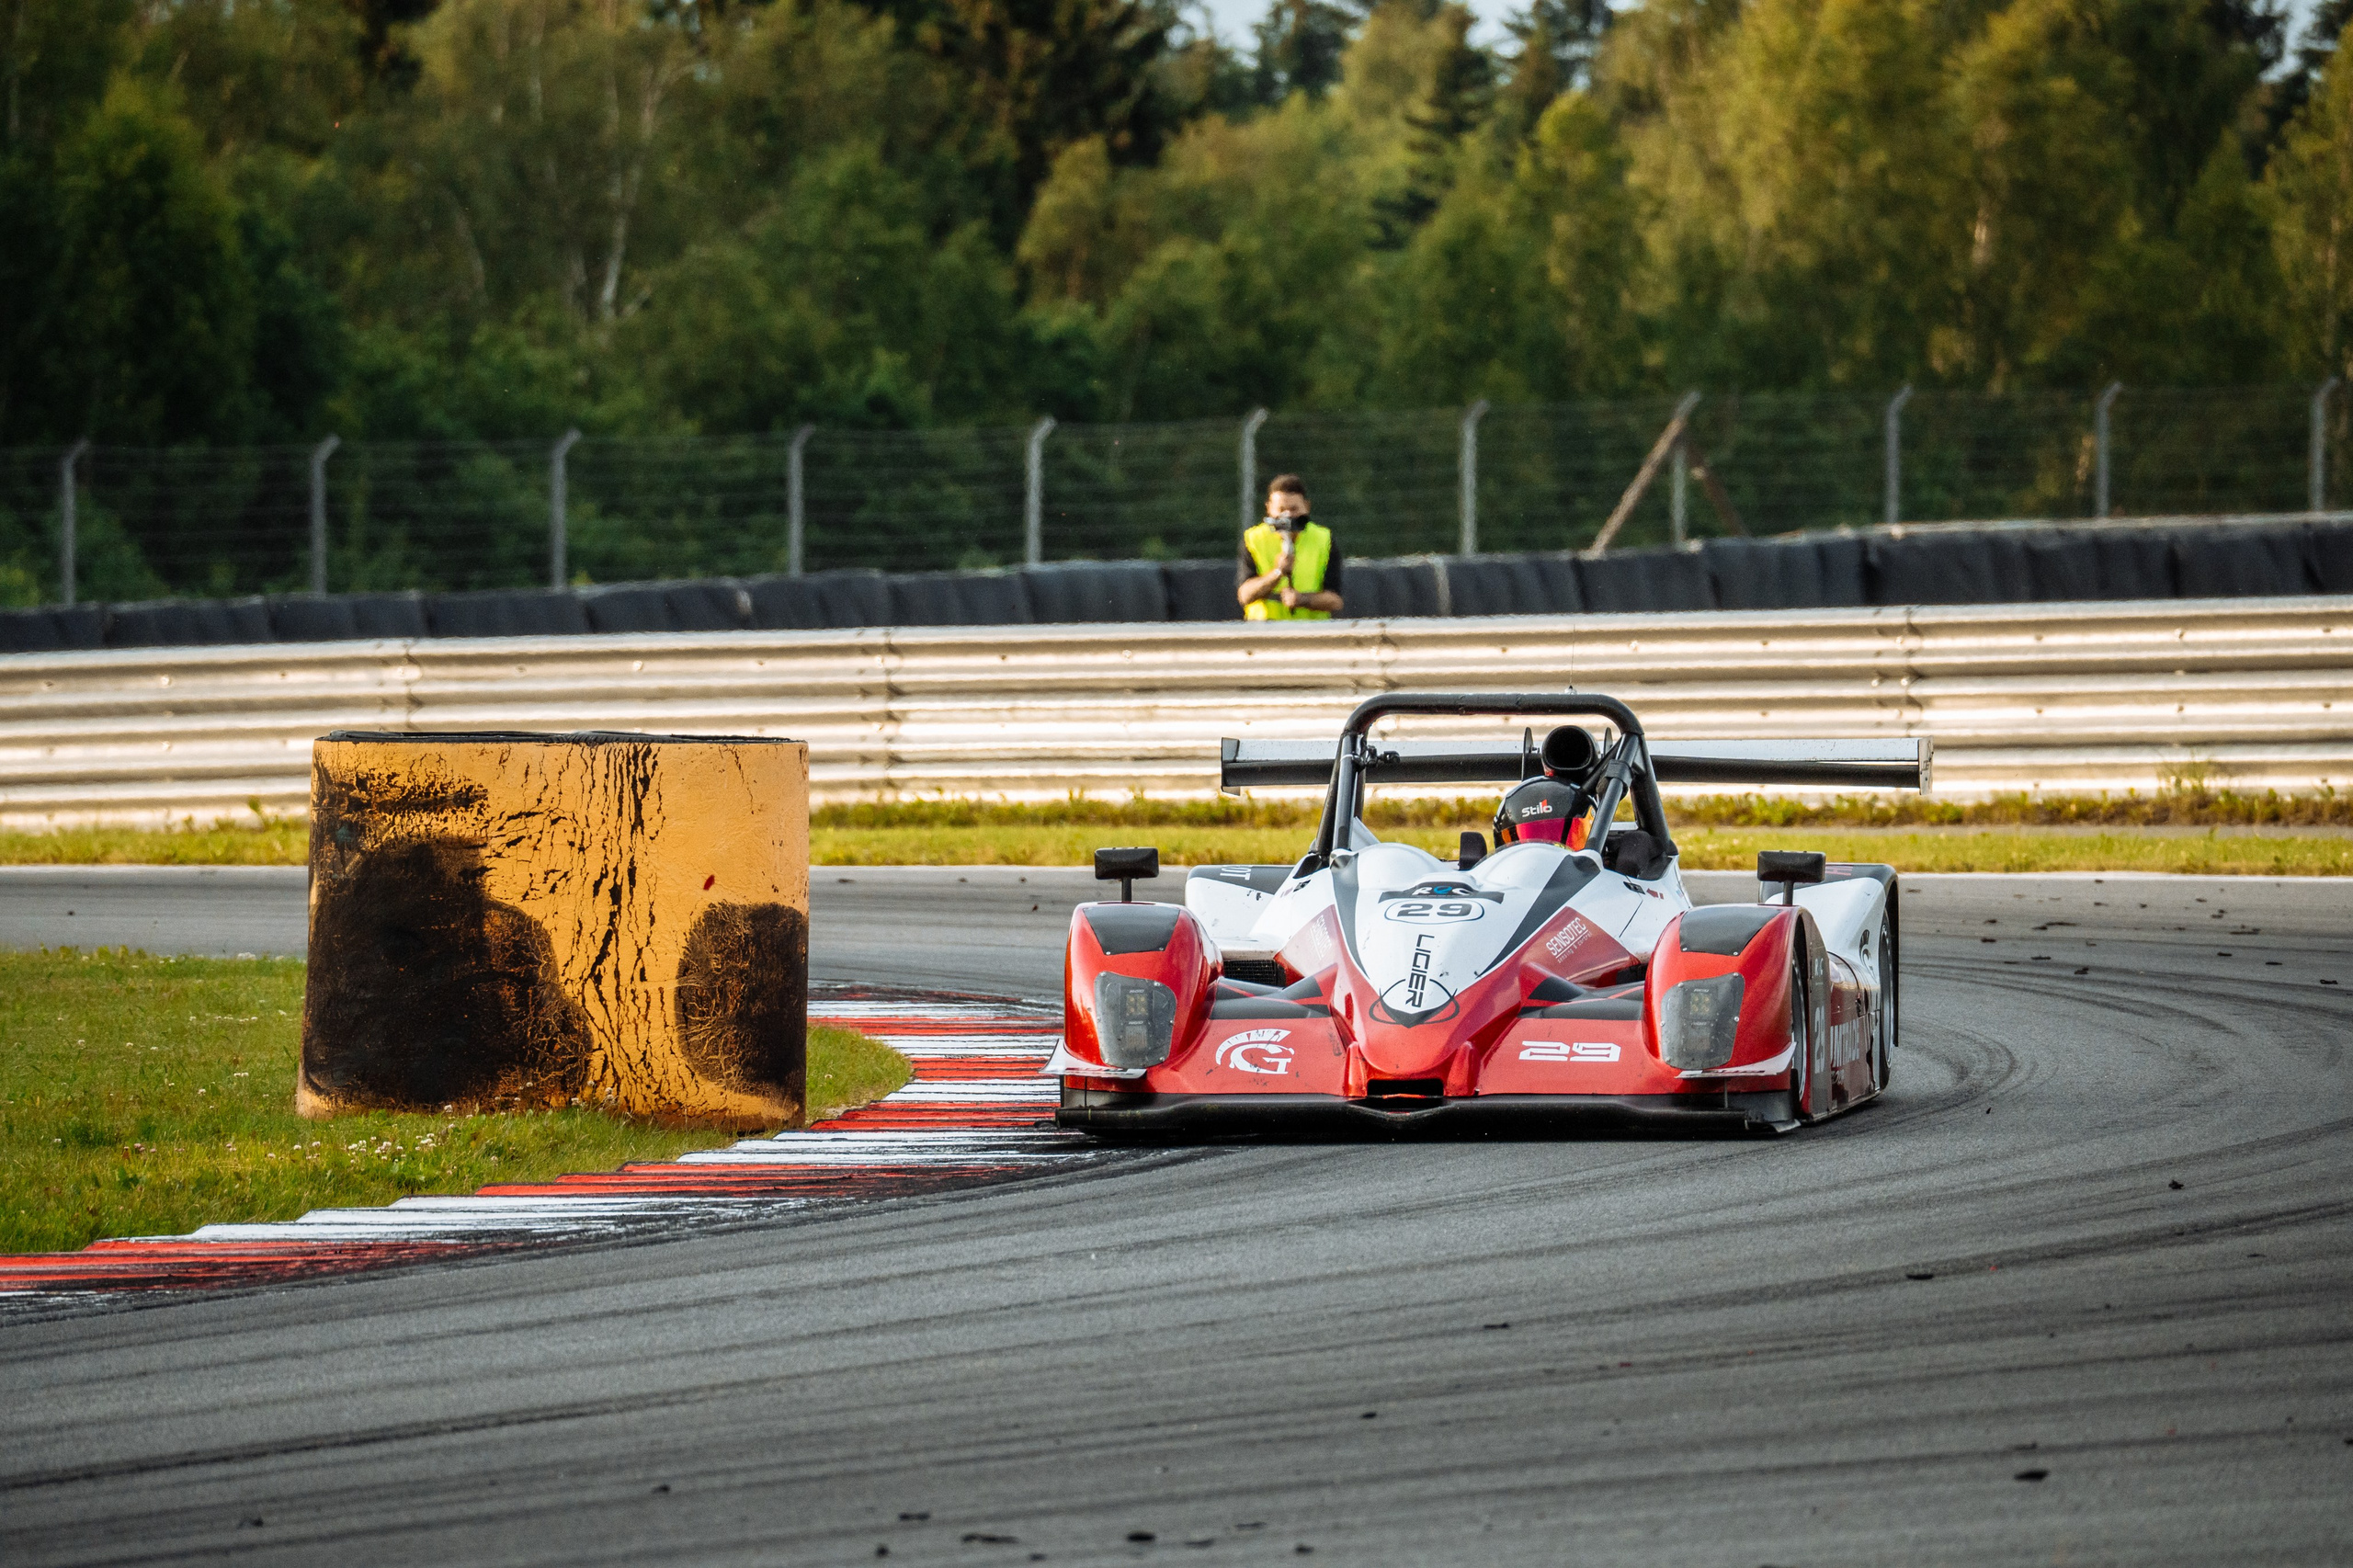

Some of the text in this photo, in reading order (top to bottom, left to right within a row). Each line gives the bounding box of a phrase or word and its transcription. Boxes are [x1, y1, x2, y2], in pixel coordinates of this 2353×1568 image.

[1521, 800, 1553, 817] Stilo
[1397, 903, 1472, 917] 29
[1546, 916, 1586, 957] SENSOTEC
[1405, 934, 1435, 1007] LIGIER
[1518, 1040, 1621, 1062] 29
[1814, 1006, 1825, 1074] 29
